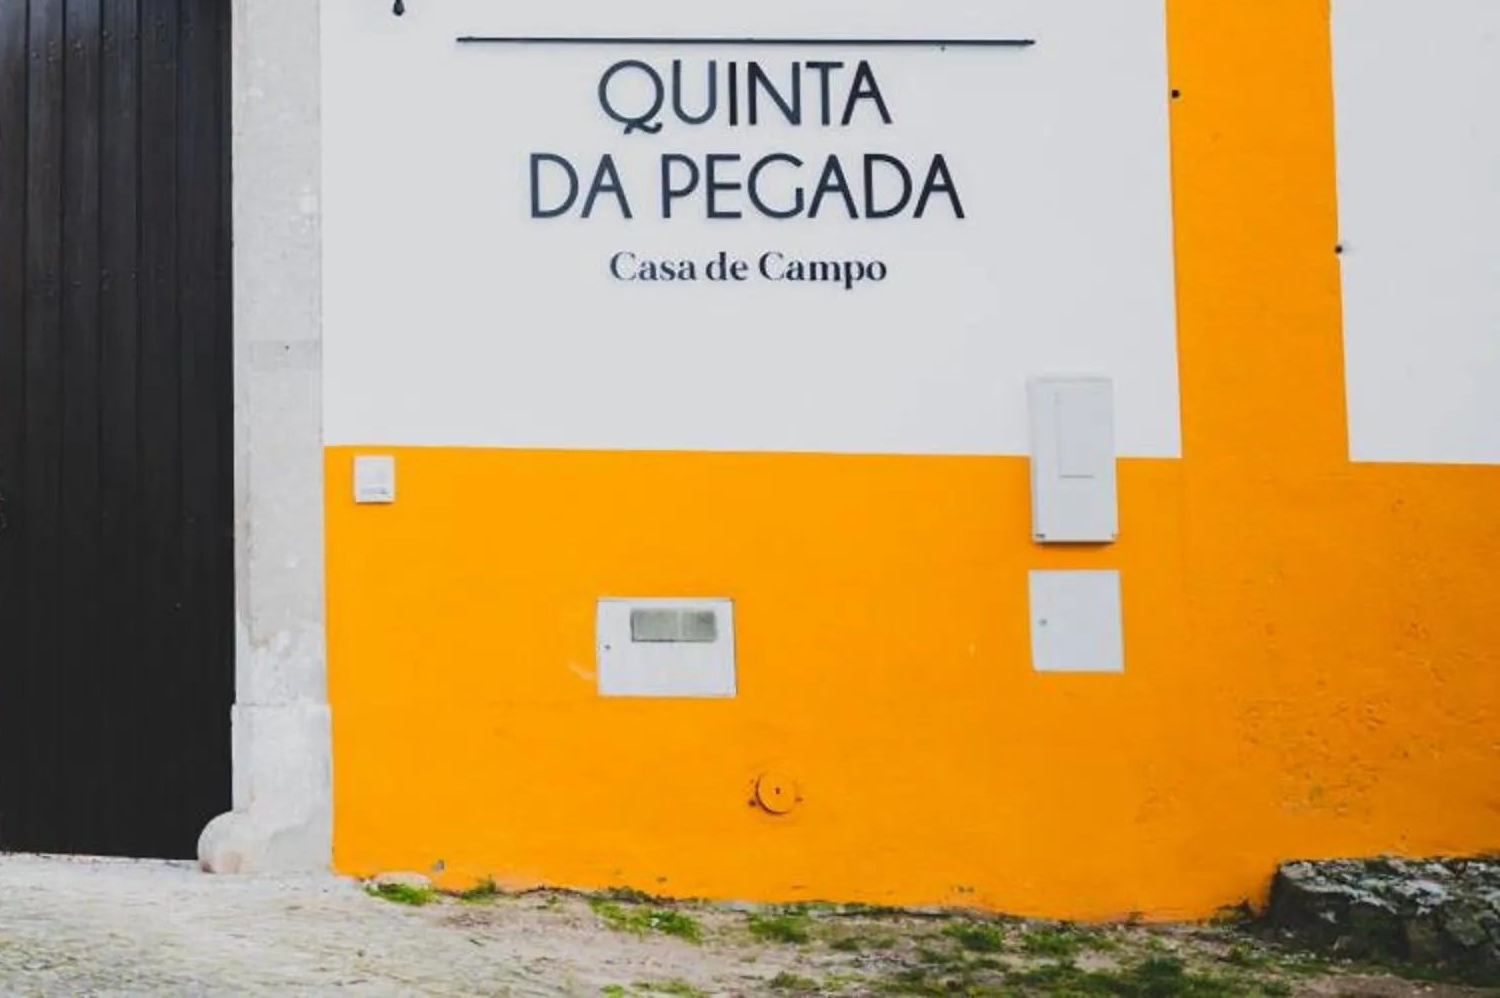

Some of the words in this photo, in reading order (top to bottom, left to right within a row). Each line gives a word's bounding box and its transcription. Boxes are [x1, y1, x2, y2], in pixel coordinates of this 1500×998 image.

[598, 59, 893, 135] QUINTA
[530, 153, 633, 219] DA
[661, 153, 965, 220] PEGADA
[610, 251, 697, 282] Casa
[705, 251, 749, 282] de
[758, 251, 888, 291] Campo
